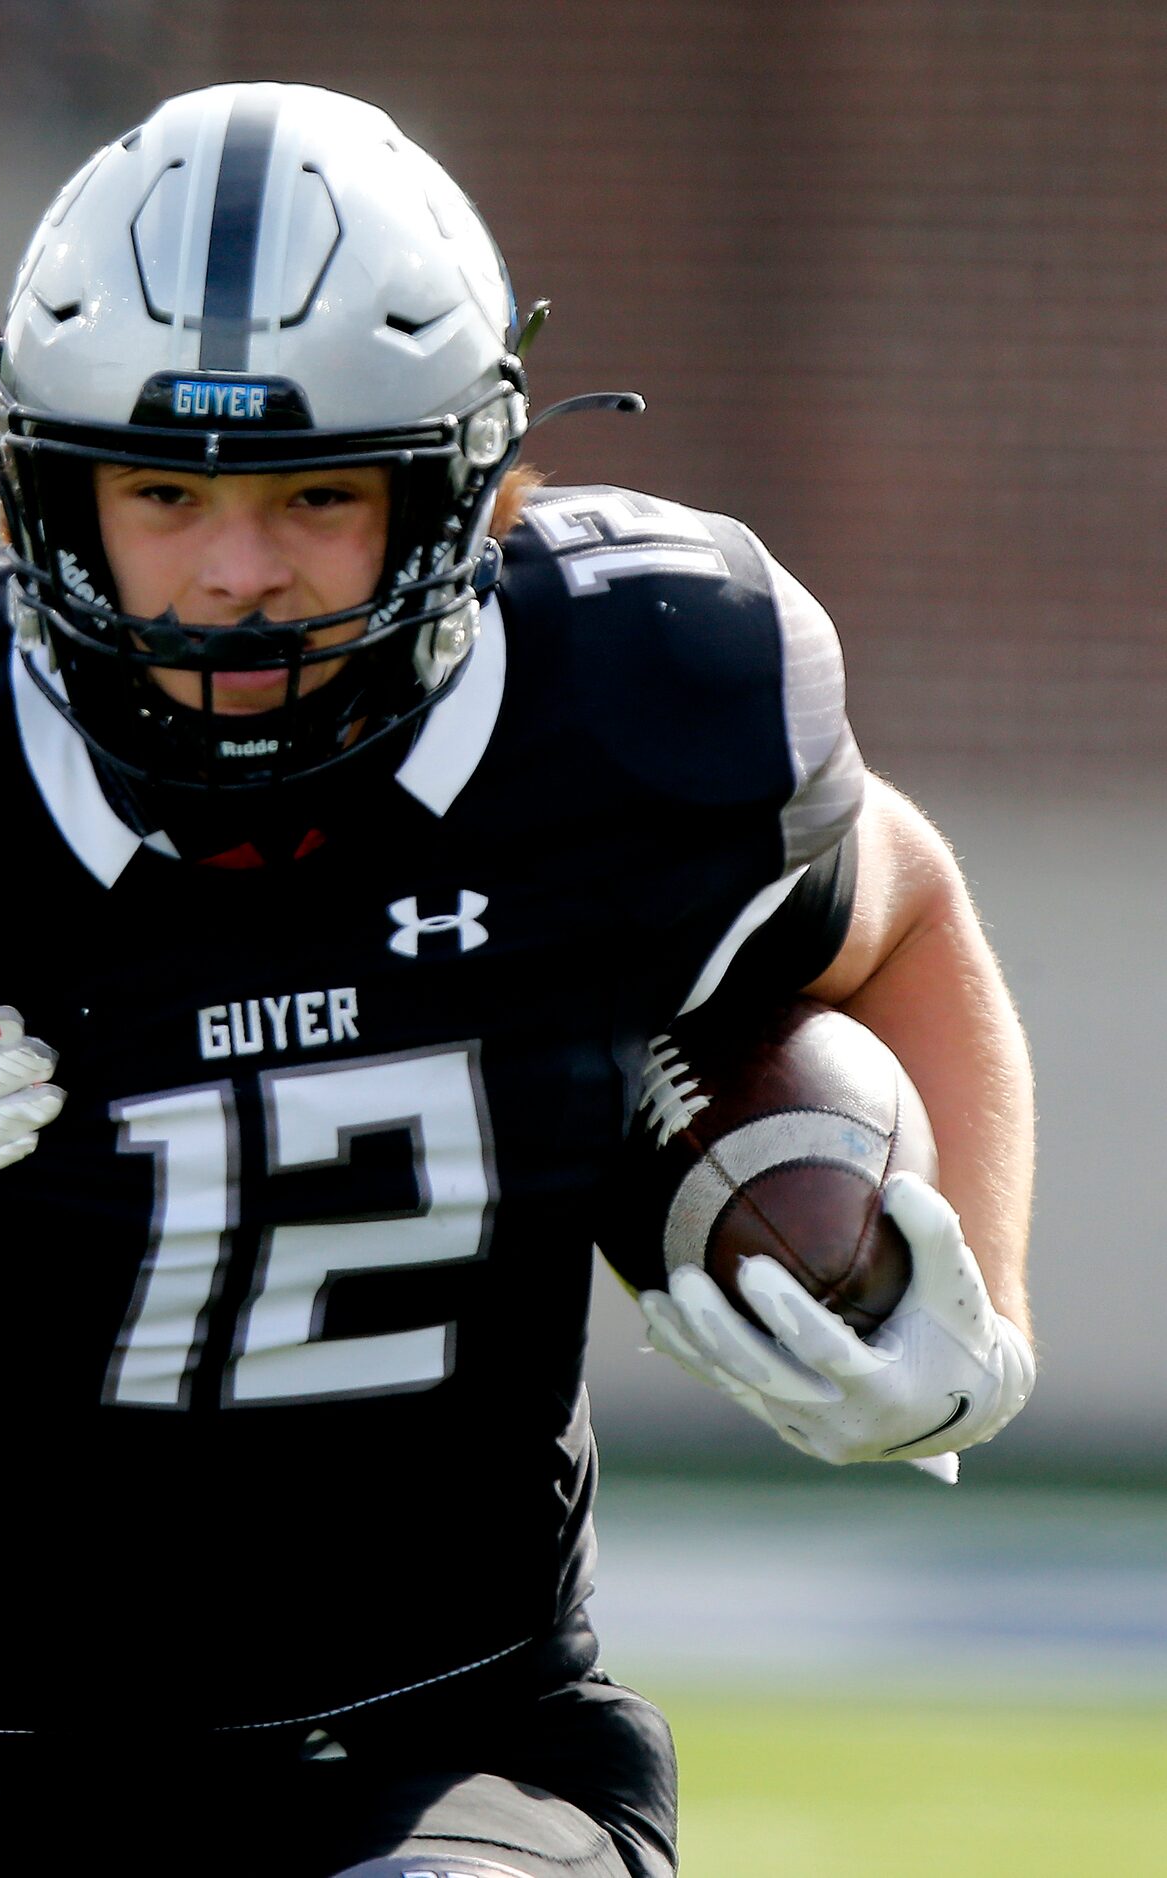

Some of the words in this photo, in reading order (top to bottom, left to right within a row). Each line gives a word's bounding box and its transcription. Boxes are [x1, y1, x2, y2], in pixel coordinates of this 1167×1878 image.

[175, 382, 268, 418] GUYER
[522, 493, 731, 598] 12
[198, 987, 360, 1060] GUYER
[101, 1039, 501, 1411] 12
